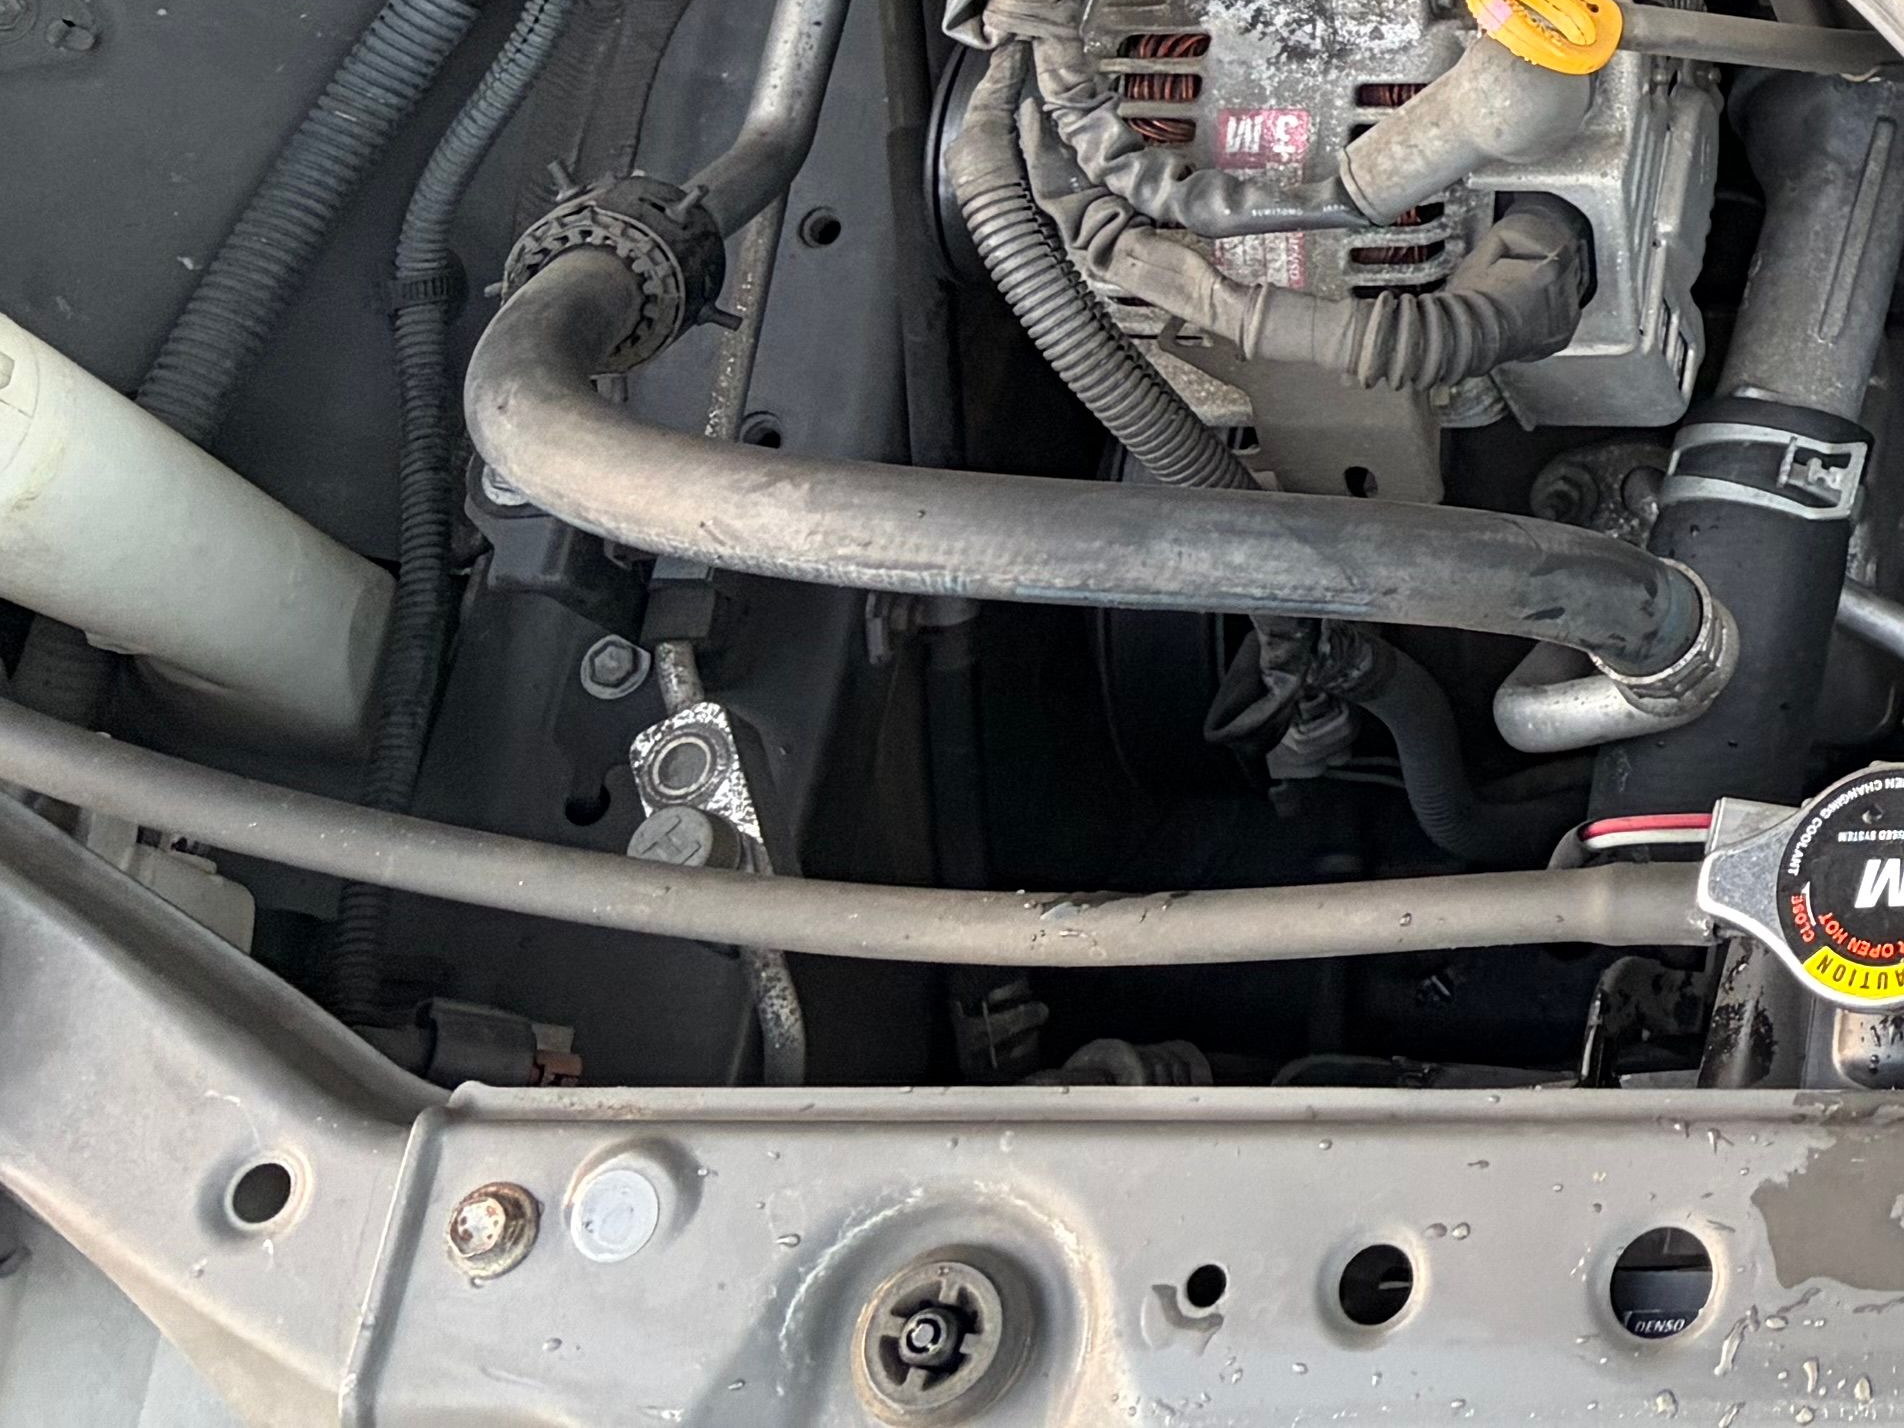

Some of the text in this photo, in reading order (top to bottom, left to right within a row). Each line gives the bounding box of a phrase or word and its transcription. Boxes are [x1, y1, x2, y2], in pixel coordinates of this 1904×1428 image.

[1819, 778, 1882, 819] CHANGING
[1786, 816, 1823, 876] COOLANT
[1790, 893, 1816, 942] CLOSE
[1817, 911, 1848, 943] HOT
[1846, 936, 1894, 958] OPEN
